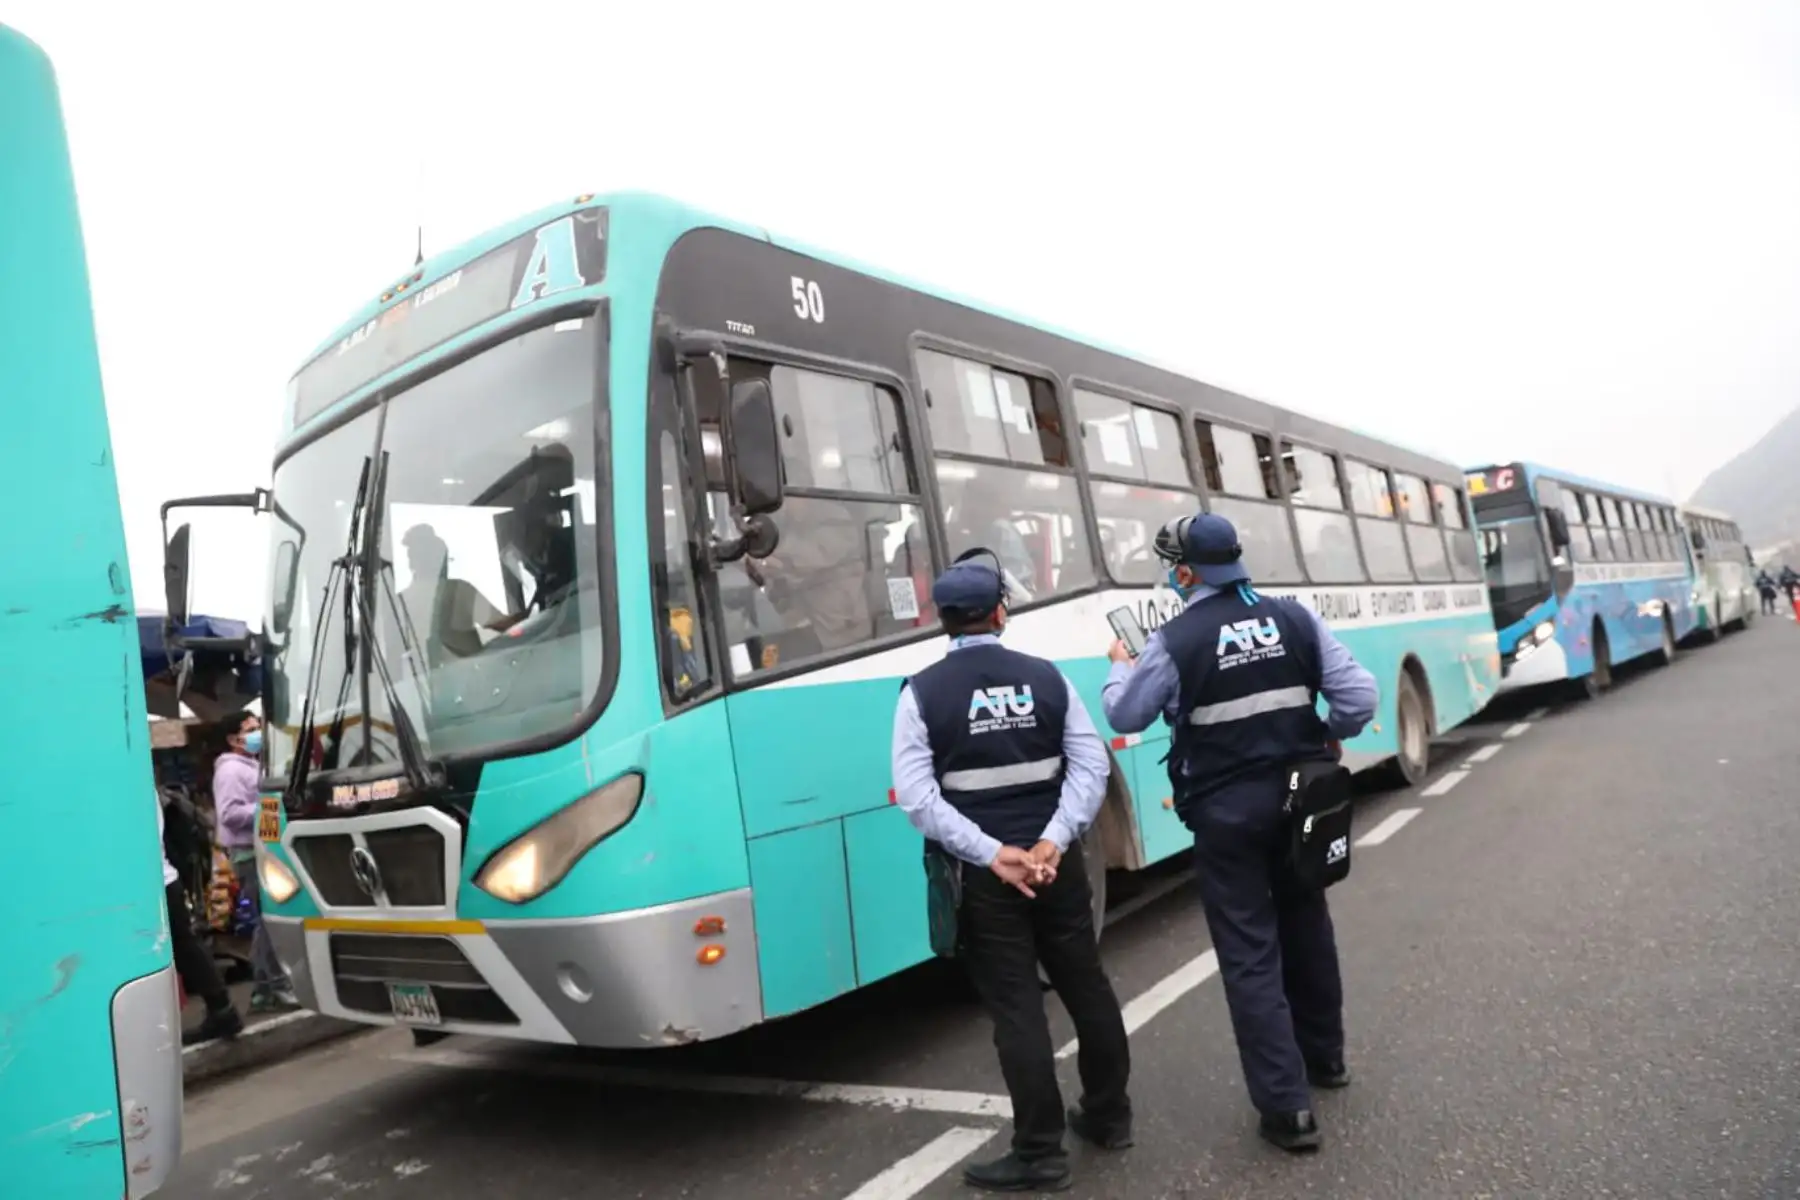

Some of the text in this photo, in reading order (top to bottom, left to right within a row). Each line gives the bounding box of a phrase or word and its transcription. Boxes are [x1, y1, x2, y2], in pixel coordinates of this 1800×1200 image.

[511, 215, 586, 309] A
[790, 275, 825, 323] 50
[1216, 616, 1281, 656] ATU
[967, 684, 1034, 720] ATU
